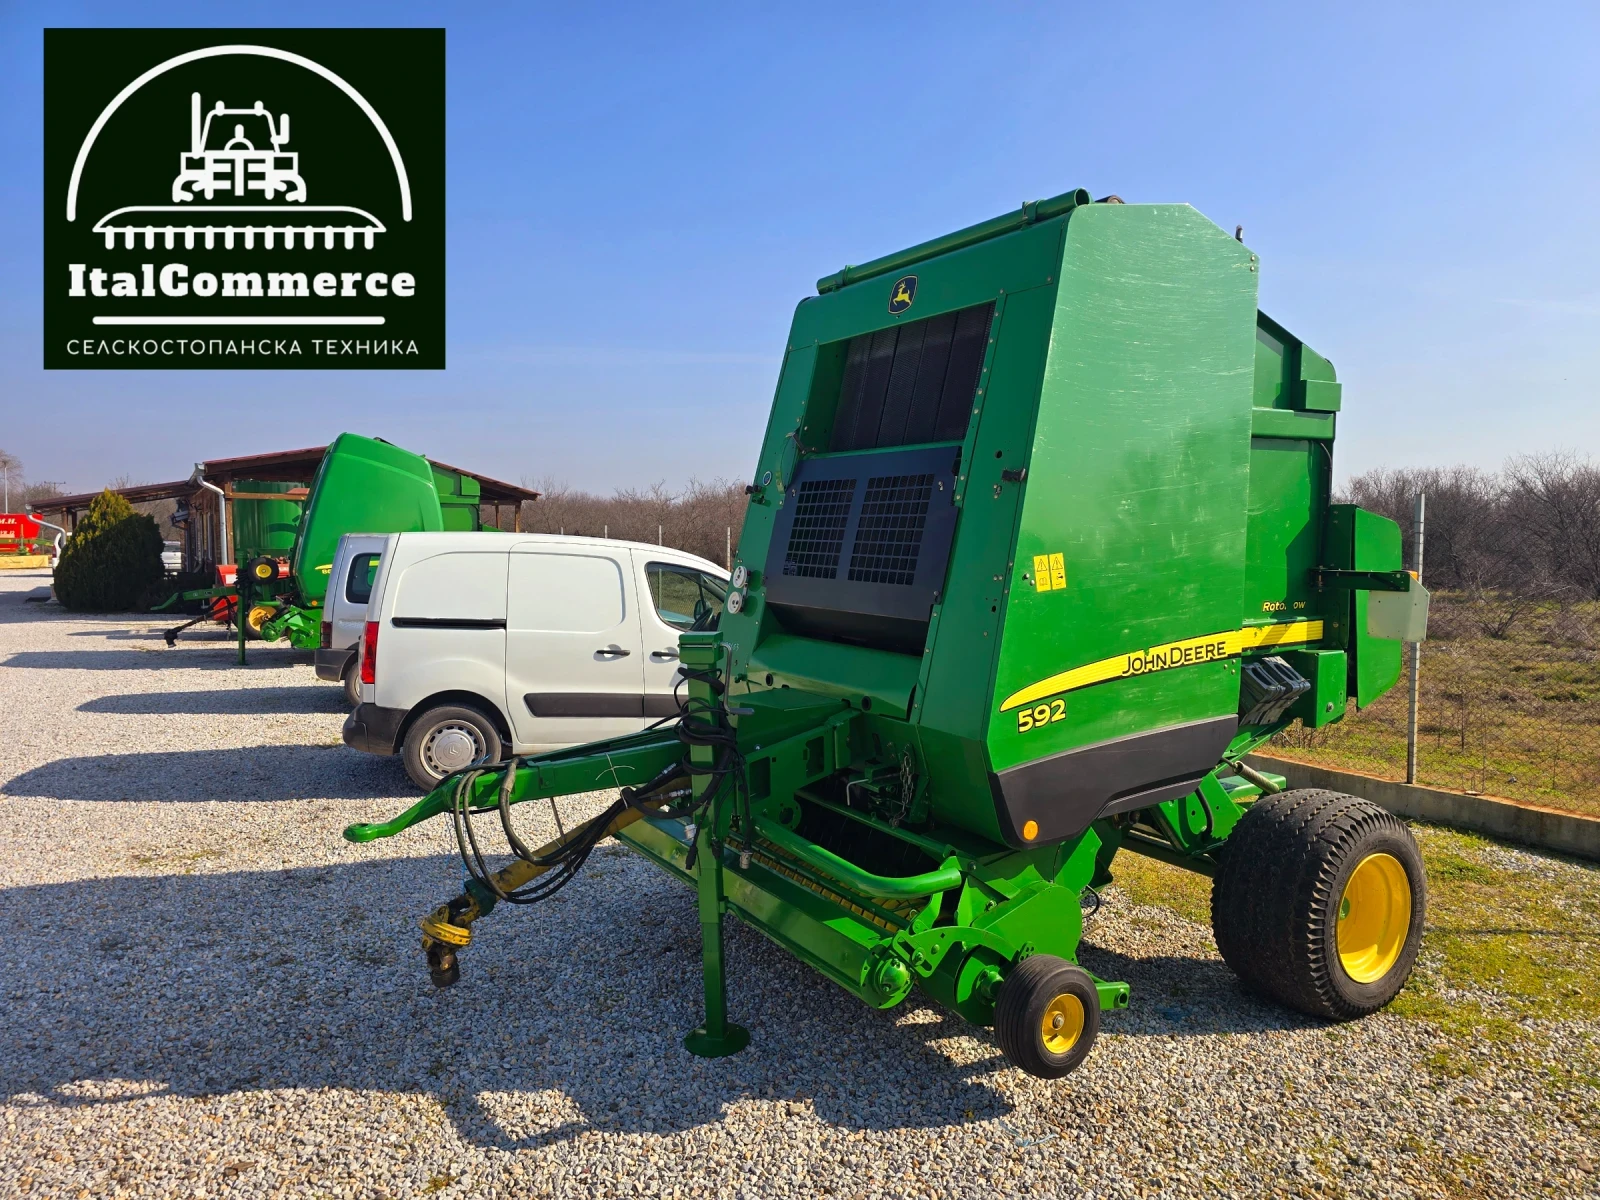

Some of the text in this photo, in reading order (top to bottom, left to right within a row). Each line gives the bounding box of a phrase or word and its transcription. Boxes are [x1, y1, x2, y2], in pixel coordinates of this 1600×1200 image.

[1122, 641, 1227, 675] JOHN DEERE
[1017, 699, 1067, 734] 592
